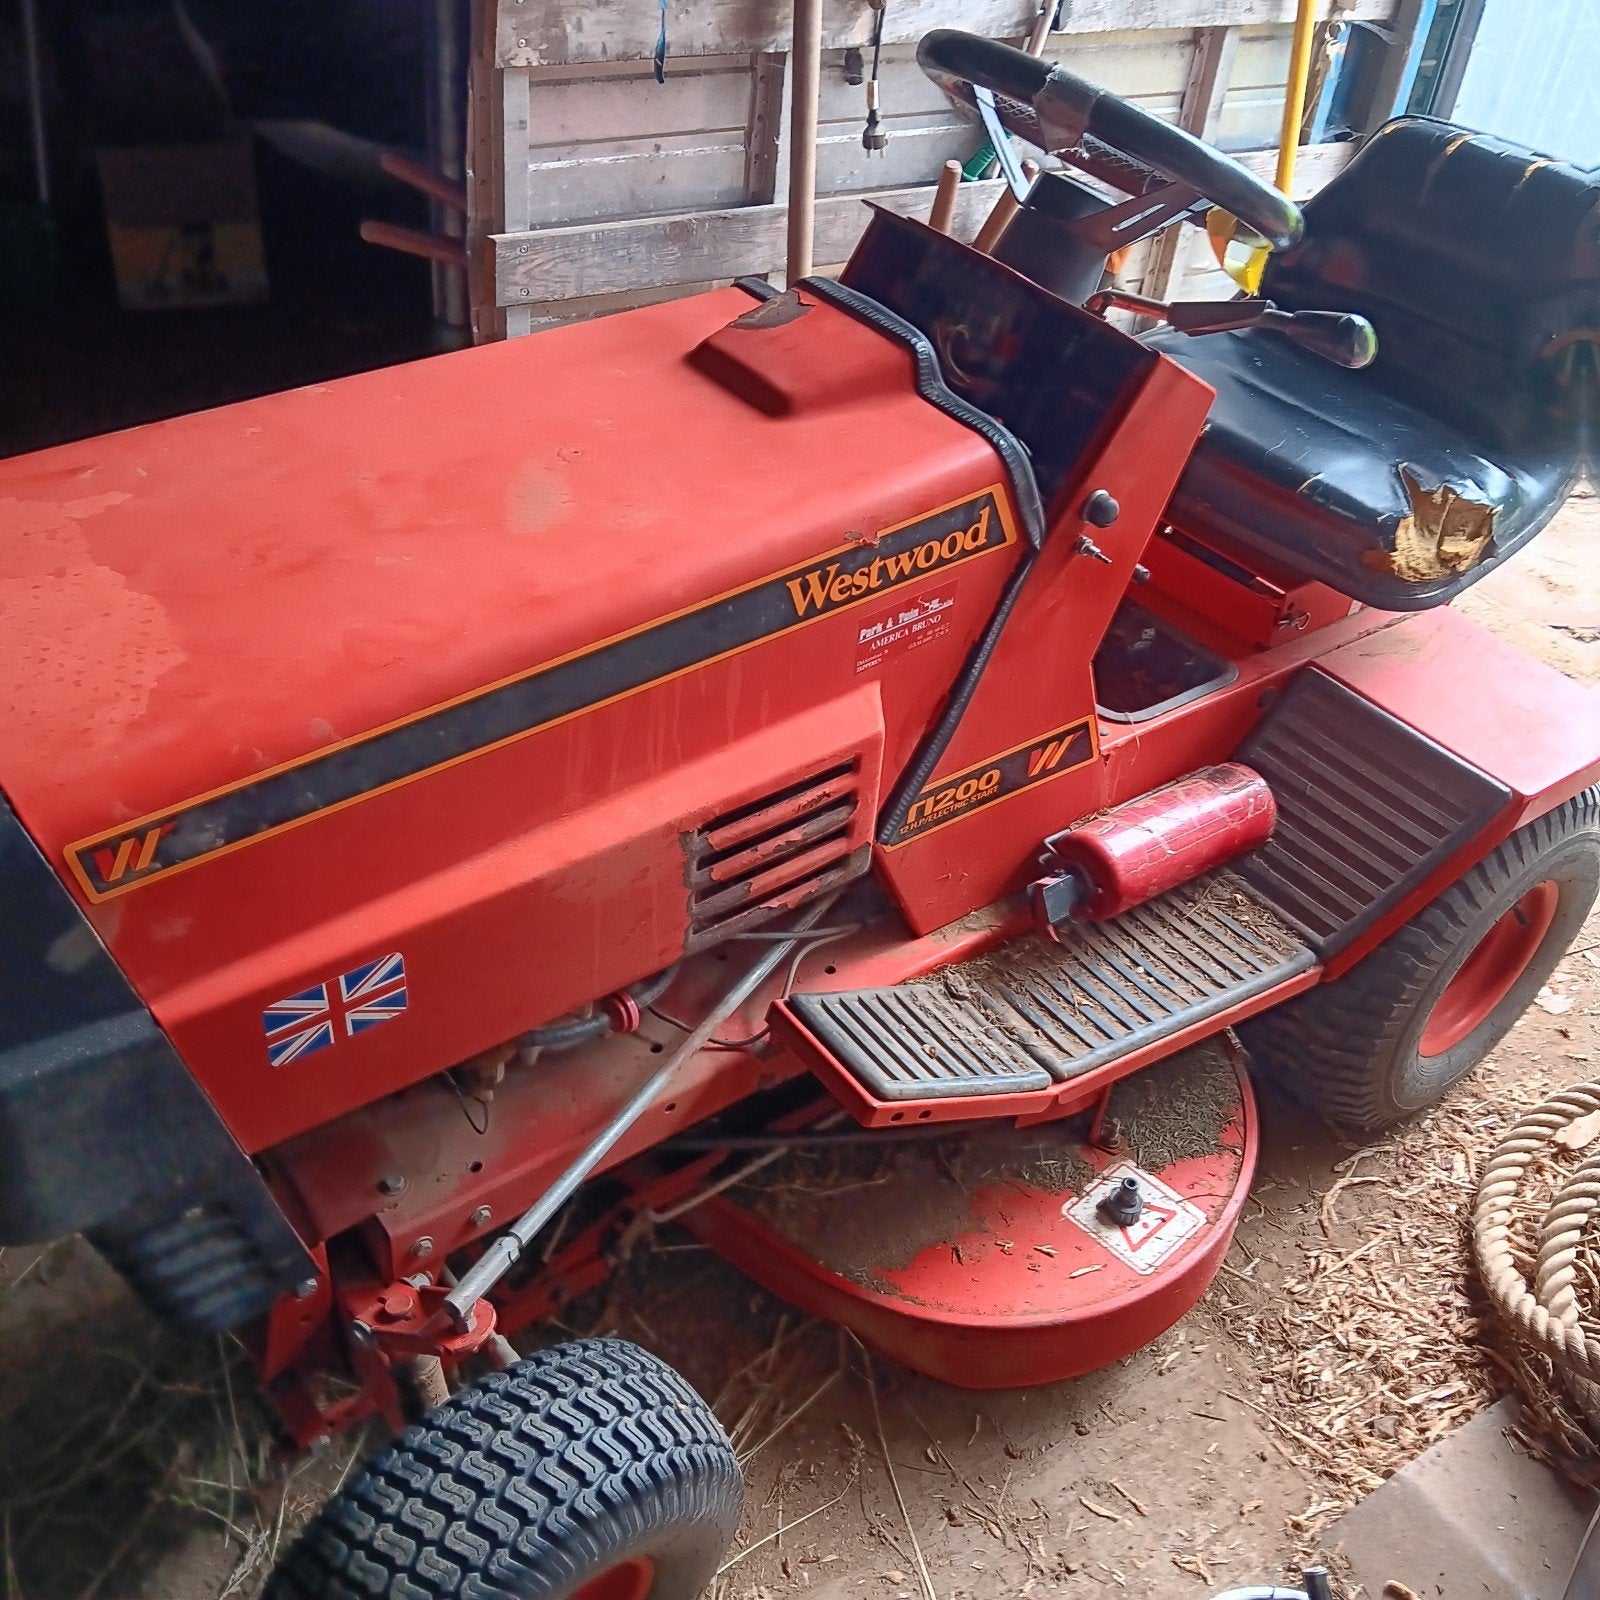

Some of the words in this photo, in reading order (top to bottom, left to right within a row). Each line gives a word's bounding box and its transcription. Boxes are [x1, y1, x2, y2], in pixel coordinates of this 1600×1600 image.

[786, 505, 991, 617] Westwood
[859, 622, 883, 640] Park
[869, 627, 909, 651] AMERICA
[911, 614, 941, 633] BRUNO
[969, 785, 999, 803] START
